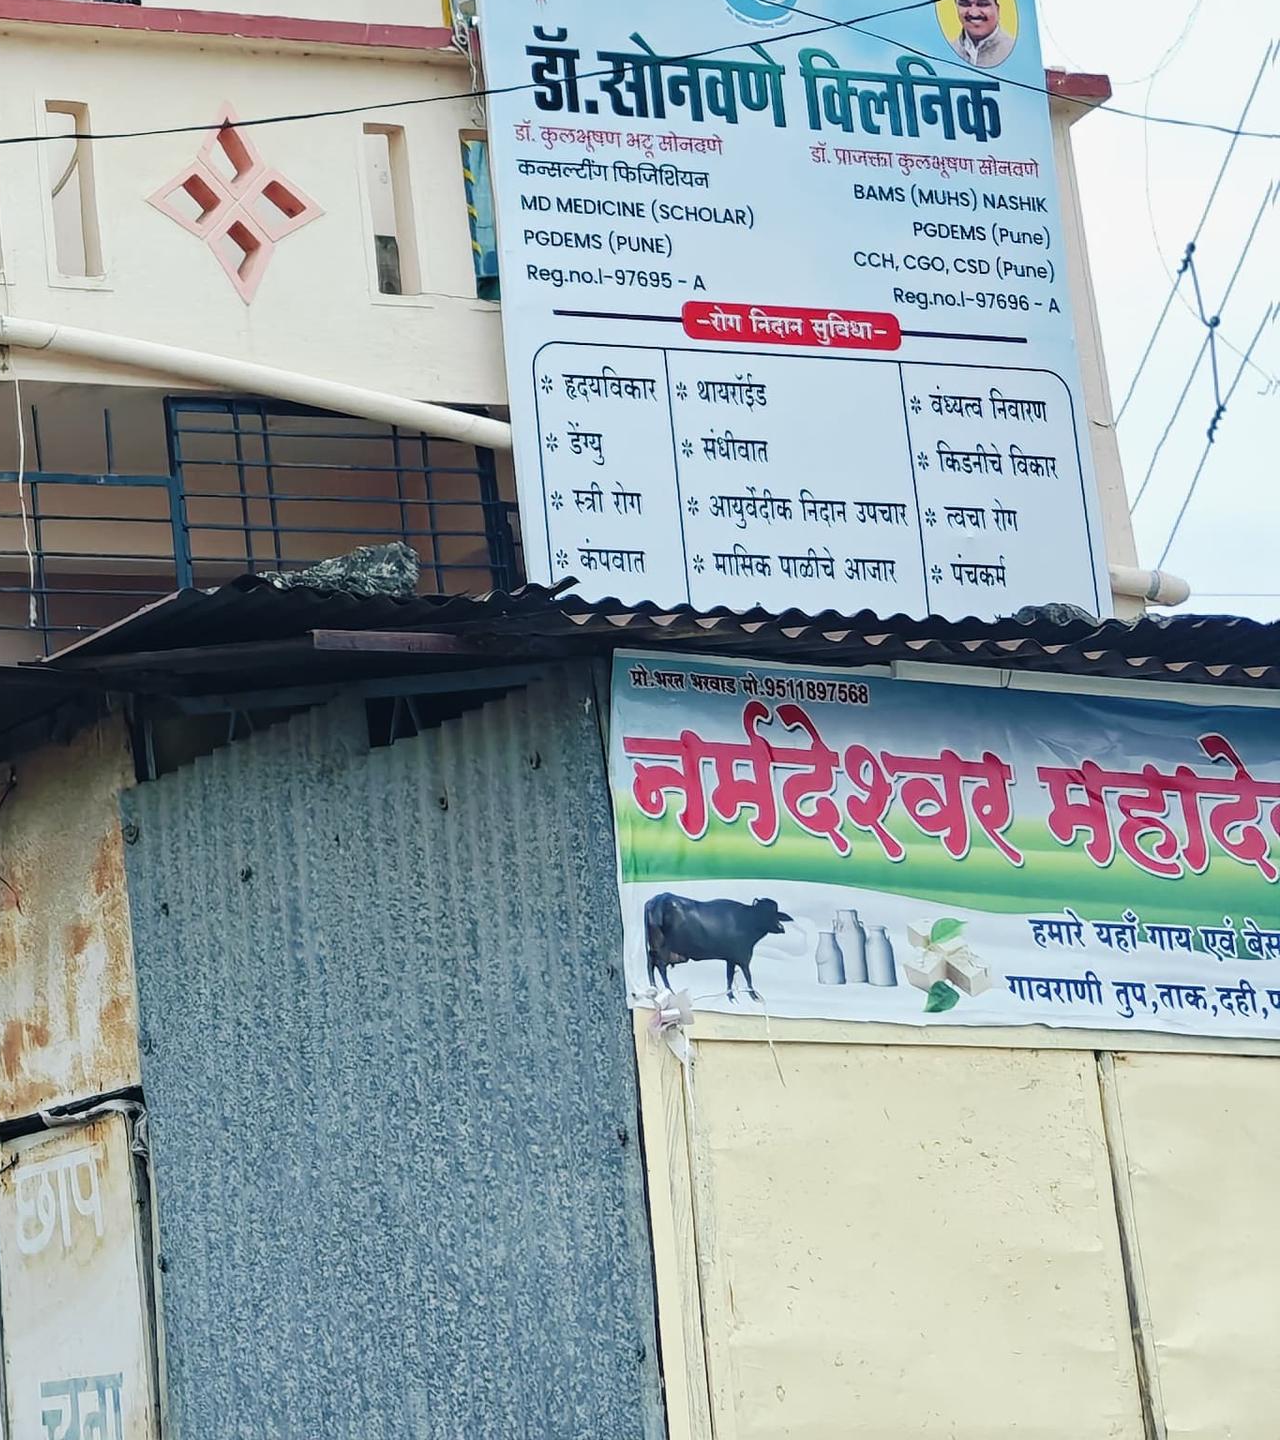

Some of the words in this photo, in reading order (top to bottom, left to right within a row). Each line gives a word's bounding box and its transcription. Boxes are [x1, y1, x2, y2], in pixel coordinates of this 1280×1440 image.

[798, 47, 1003, 142] क्लिनिक
[514, 120, 536, 142] डॉ.
[539, 126, 621, 153] कुलभूषण
[658, 131, 724, 155] सोनवणे
[516, 158, 609, 182] कन्सल्टींग
[613, 161, 710, 188] फिजिशियन
[809, 142, 831, 164] डॉ.
[896, 153, 974, 179] कुलभूषण
[978, 155, 1040, 178] सोनवणे
[520, 194, 551, 211] MD
[557, 197, 646, 219] MEDICINE
[651, 199, 754, 229] (SCHOLAR)
[854, 184, 905, 203] BAMS
[910, 184, 977, 211] (MUHS)
[983, 194, 1049, 213] NASHIK
[523, 229, 602, 250] PGDEMS
[608, 230, 673, 258] (PUNE)
[913, 222, 986, 241] PGDEMS
[991, 223, 1051, 250] (Pune)
[693, 275, 707, 291] A
[853, 251, 900, 272] CCH,
[903, 254, 950, 276] CGO,
[953, 257, 990, 275] CSD
[995, 256, 1056, 283] (Pune)
[748, 307, 803, 338] निदान
[1048, 297, 1061, 313] A
[561, 365, 658, 403] हृदयविकार
[697, 373, 768, 412] थायरॉईड
[989, 387, 1048, 423] निवारण
[700, 428, 769, 463] संधीवात
[936, 440, 1003, 475] किडनीचे
[1008, 444, 1059, 480] विकार
[572, 482, 603, 513] स्त्री
[611, 481, 642, 515] रोग
[799, 489, 847, 527] निदान
[854, 501, 909, 527] उपचार
[943, 506, 987, 530] त्वचा
[992, 499, 1018, 532] रोग
[577, 538, 646, 574] कंपवात
[712, 543, 771, 578] मासिक
[778, 547, 835, 580] पाळीचे
[844, 557, 897, 584] आजार
[951, 554, 1007, 588] पंचकर्म
[690, 673, 737, 696] भरवाड
[623, 700, 1024, 867] नर्मदेश्वर
[1037, 732, 1280, 884] महादे
[1028, 908, 1085, 948] हमारे
[1092, 910, 1138, 953] यहाँ
[1145, 924, 1192, 952] गाय
[1199, 917, 1236, 961] एवं
[1005, 970, 1103, 1005] गावराणी
[12, 1142, 104, 1255] छाप
